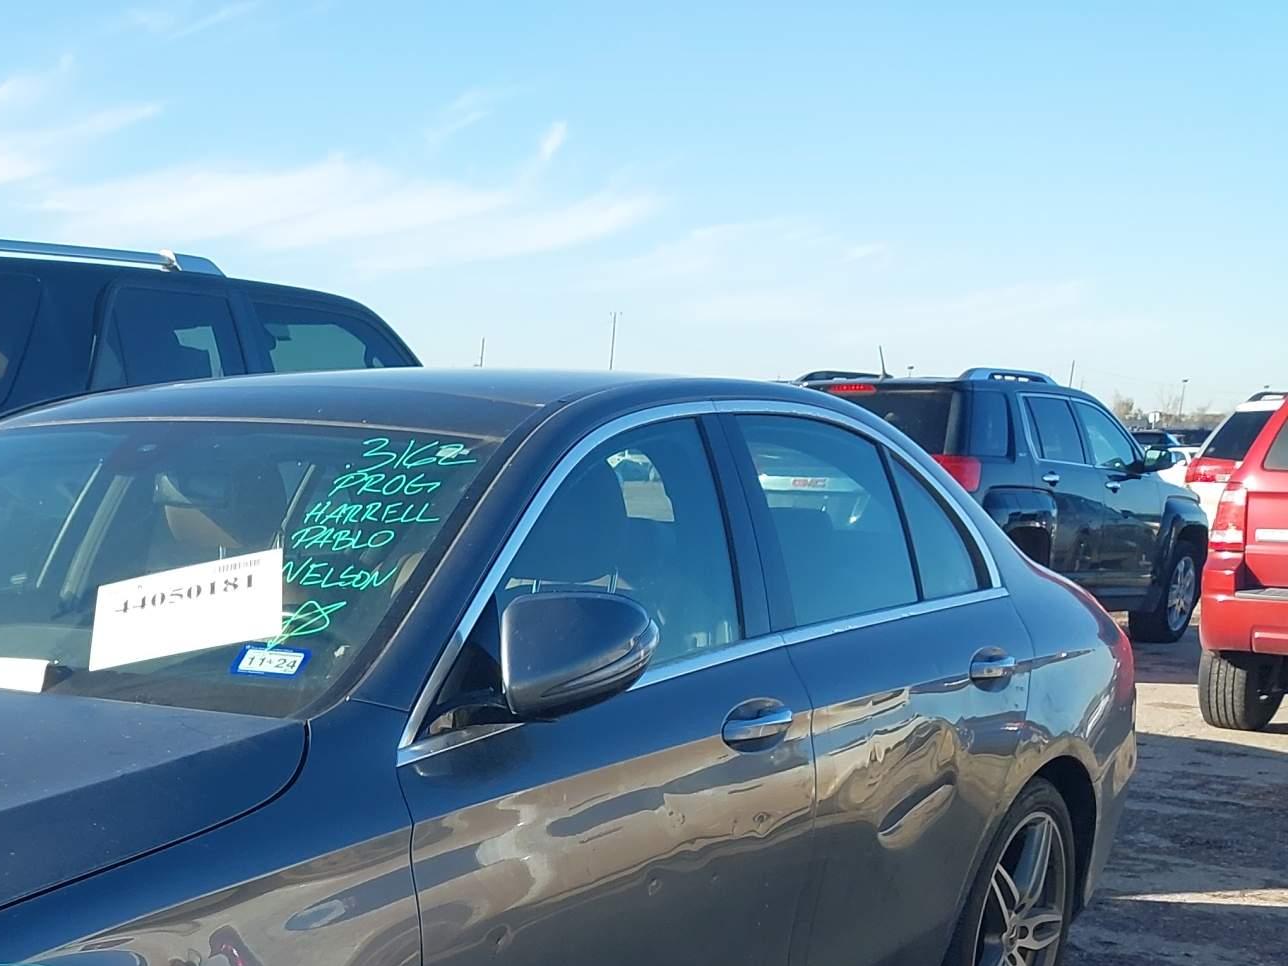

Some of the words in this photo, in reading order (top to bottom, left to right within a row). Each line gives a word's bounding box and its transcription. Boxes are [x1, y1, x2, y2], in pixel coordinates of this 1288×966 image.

[328, 473, 441, 497] PROG
[303, 501, 441, 525] HARRELL
[290, 526, 395, 551] PABLO
[282, 560, 398, 590] NELSON
[114, 574, 254, 614] 44050181
[274, 658, 298, 669] 24
